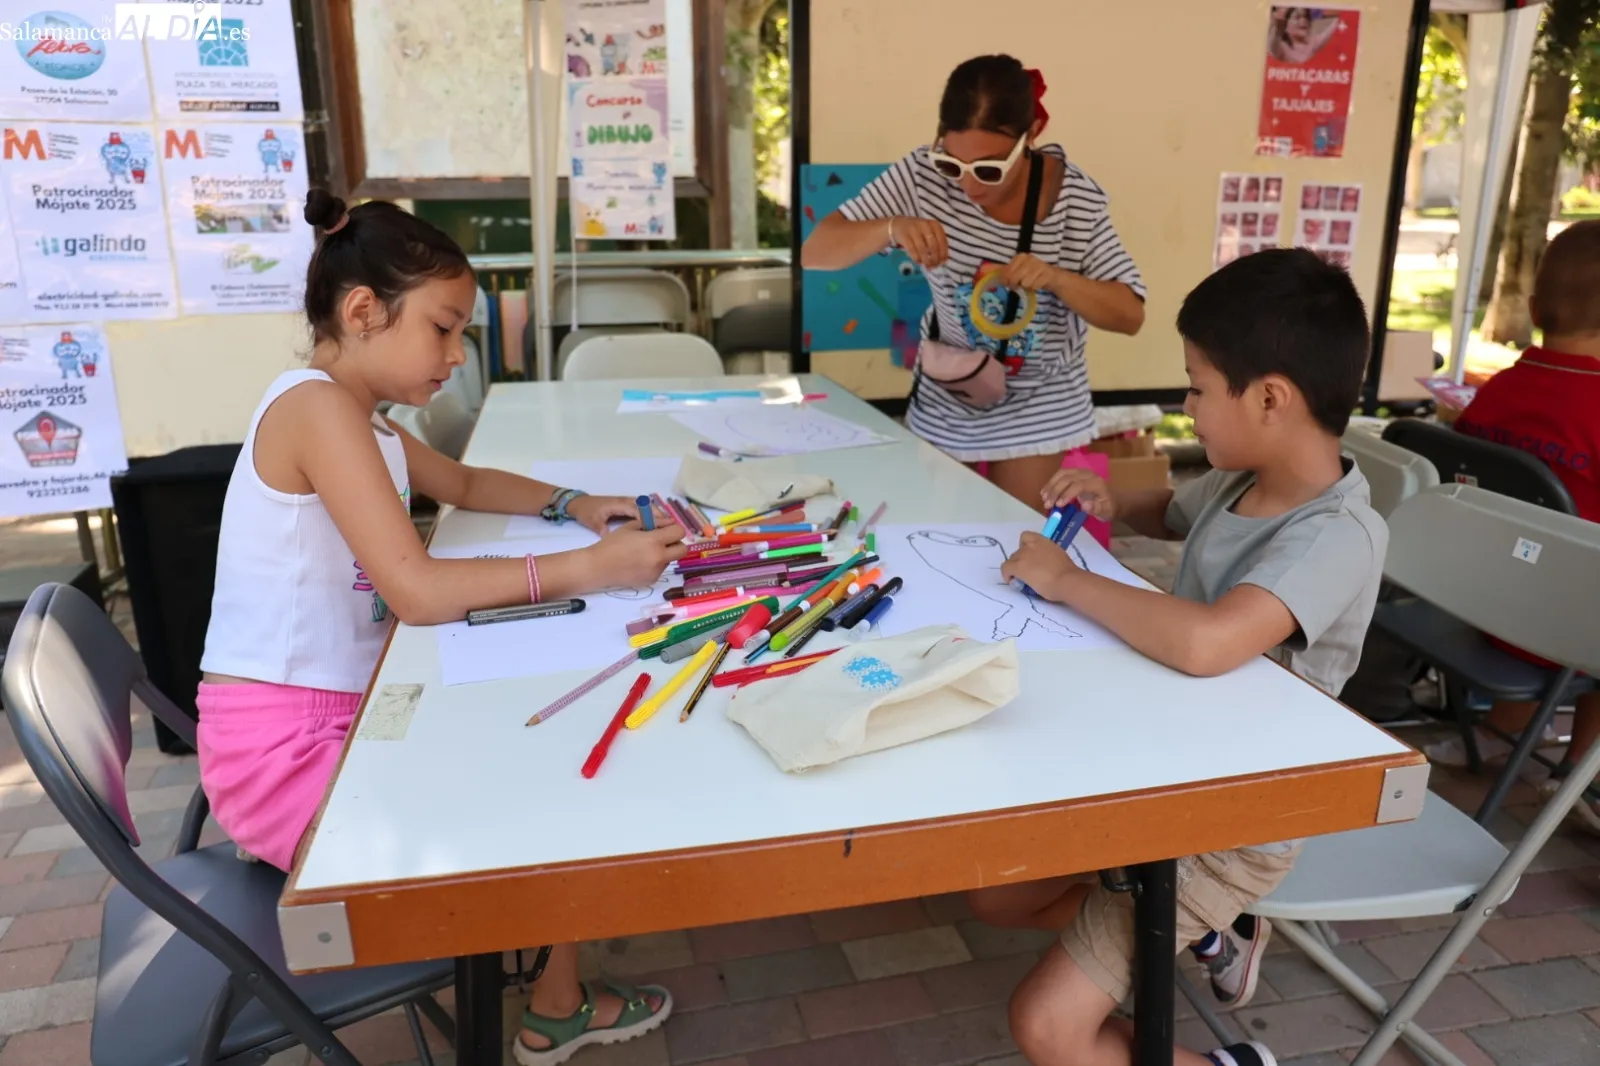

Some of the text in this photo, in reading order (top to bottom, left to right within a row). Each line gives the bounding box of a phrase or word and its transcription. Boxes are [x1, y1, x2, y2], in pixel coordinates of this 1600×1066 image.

[1267, 68, 1351, 84] PINTACARAS
[175, 80, 279, 89] PLAZA DEL MERCADO
[1300, 84, 1311, 97] Y
[586, 94, 643, 109] Concurso
[587, 124, 654, 145] DIBUJO
[4, 129, 46, 160] M
[165, 129, 203, 159] M
[190, 175, 286, 188] Patrocinador
[32, 184, 135, 198] Patrocinador
[248, 188, 286, 200] 2025
[35, 199, 137, 213] Mójate 2025
[64, 235, 146, 257] galindo
[0, 382, 86, 398] atrocinador
[0, 393, 87, 413] ójate 2025
